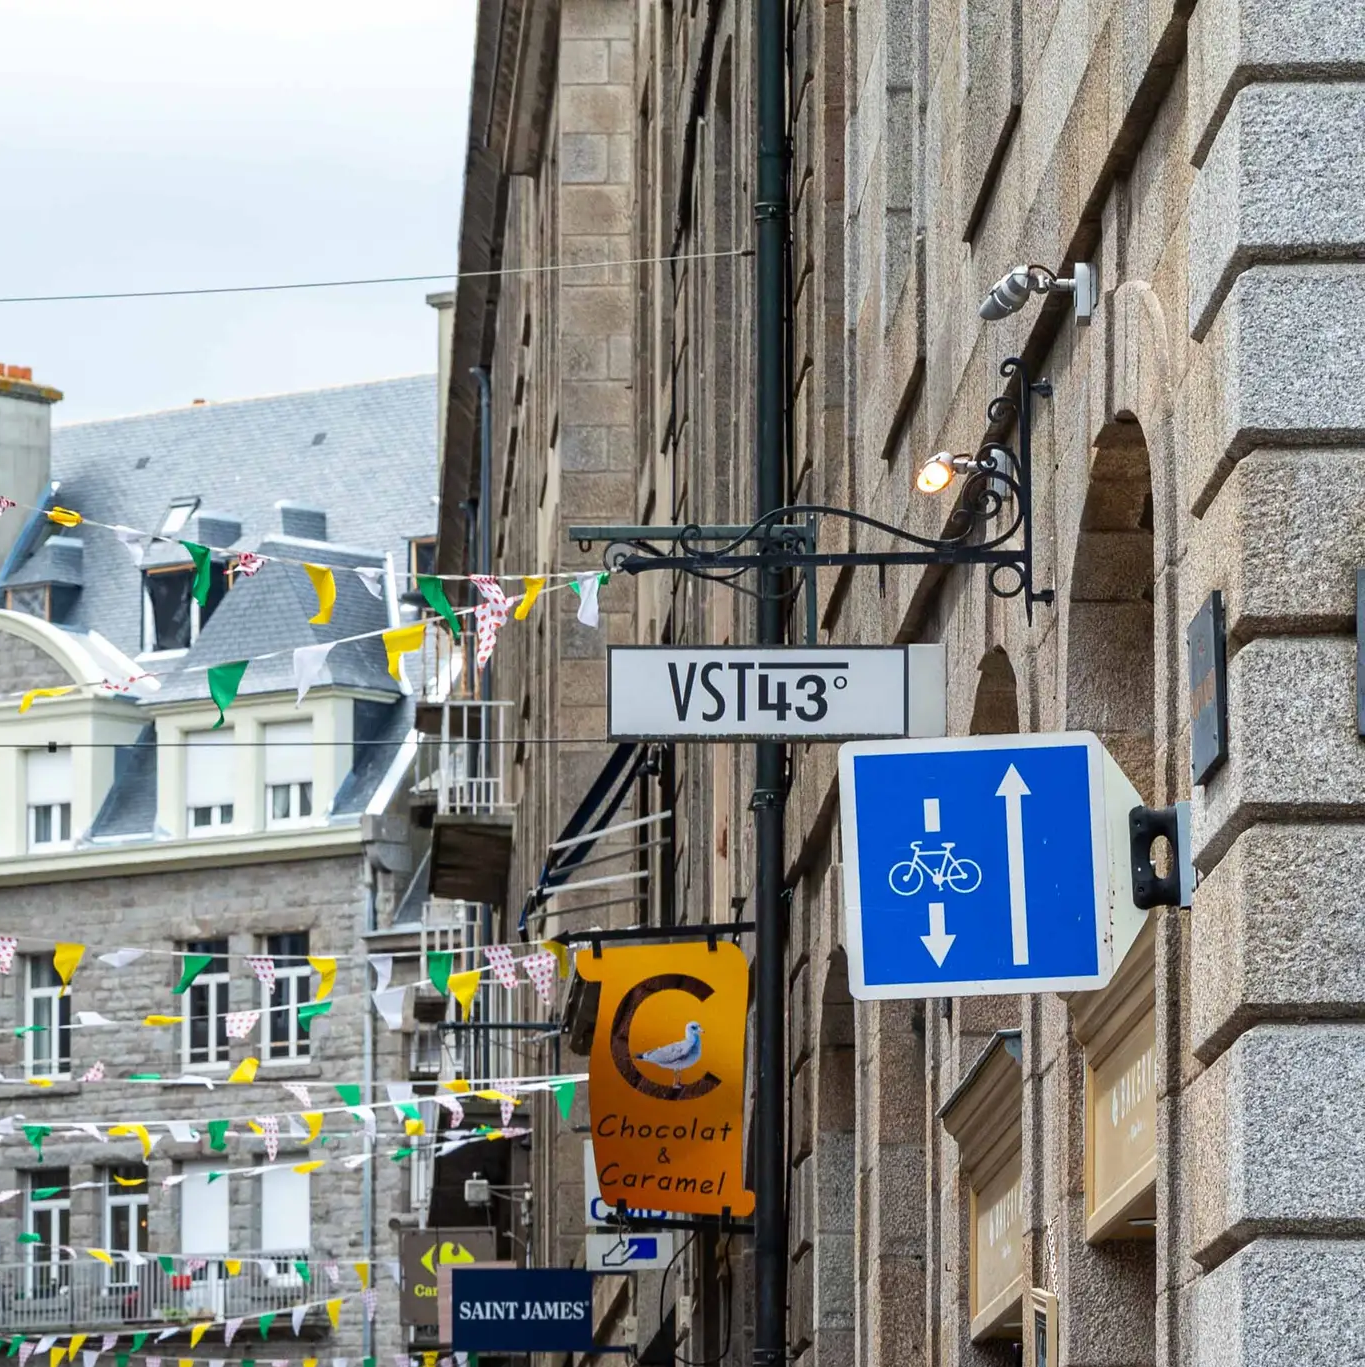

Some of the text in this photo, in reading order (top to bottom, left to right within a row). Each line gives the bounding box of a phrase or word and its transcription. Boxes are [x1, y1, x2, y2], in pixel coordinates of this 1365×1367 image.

[597, 1113, 732, 1142] Chocolat
[657, 1146, 671, 1165] &
[599, 1162, 726, 1196] Caramel
[459, 1301, 518, 1321] SAINT
